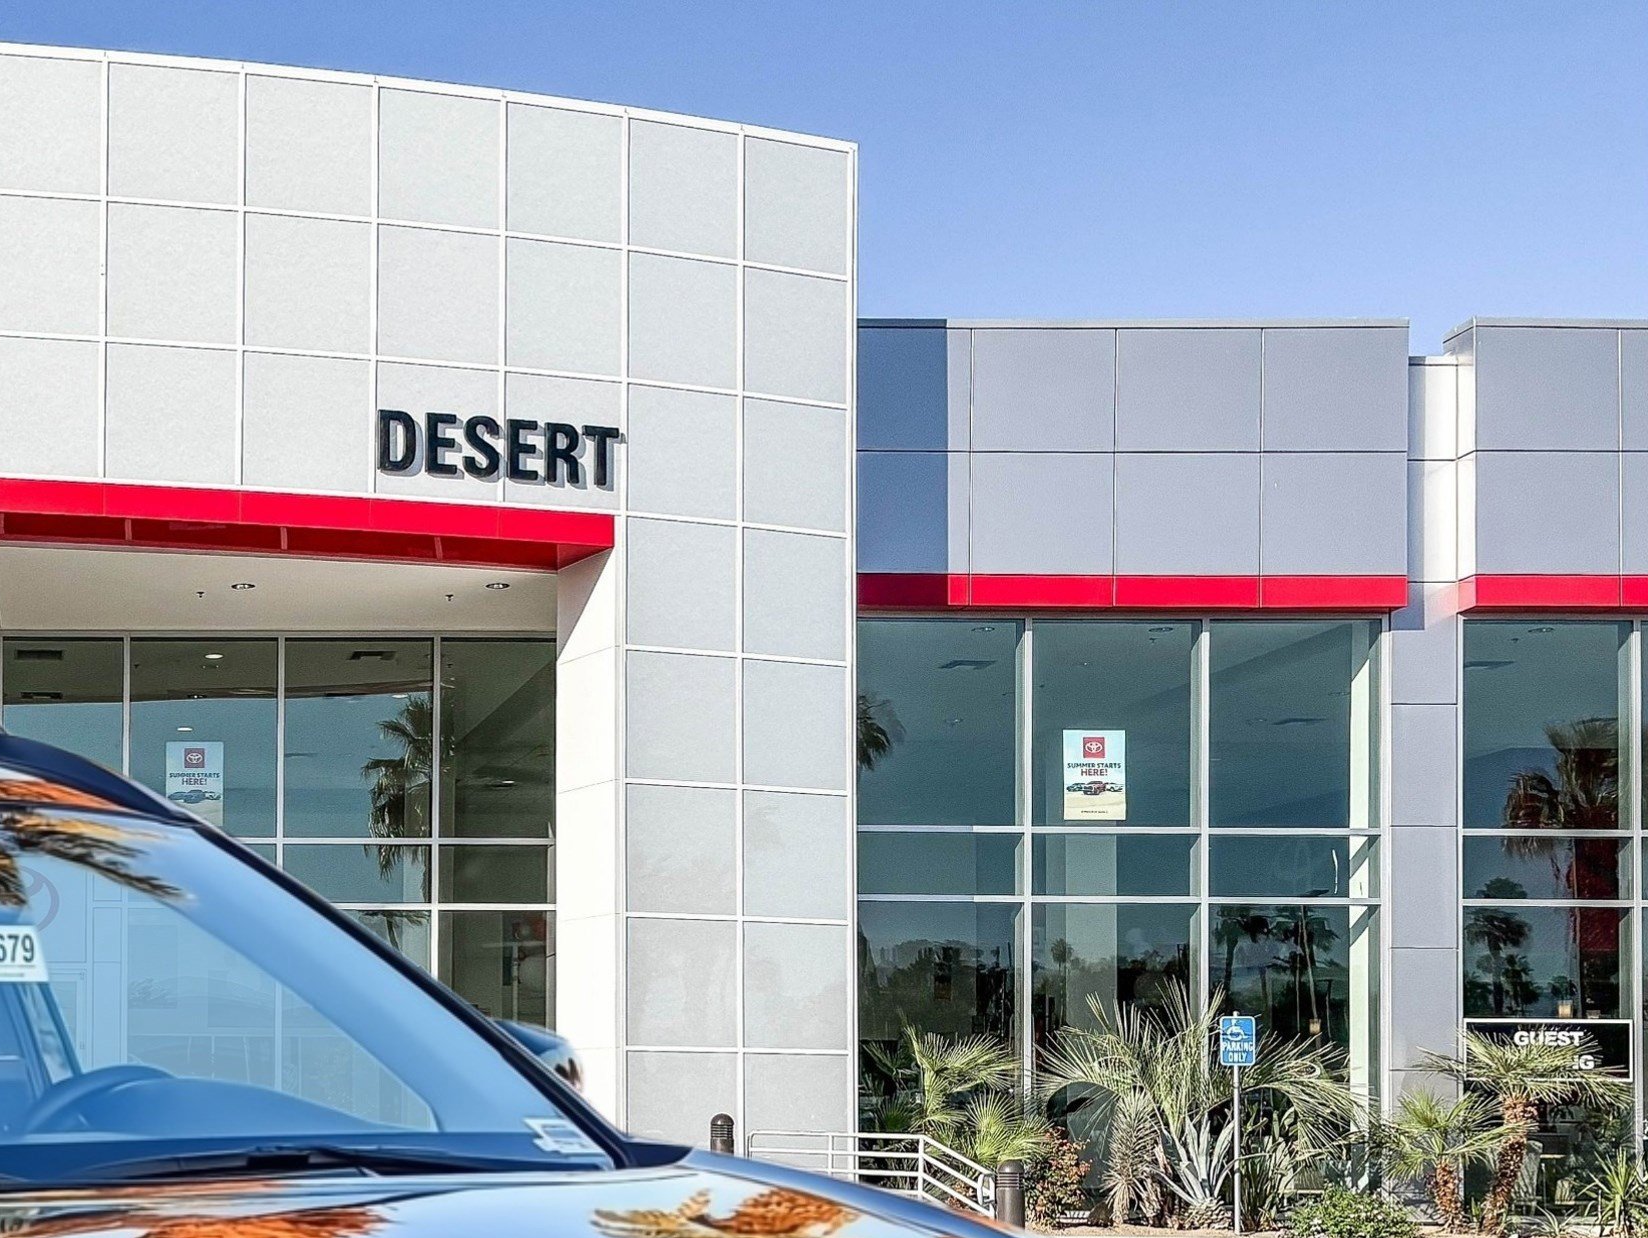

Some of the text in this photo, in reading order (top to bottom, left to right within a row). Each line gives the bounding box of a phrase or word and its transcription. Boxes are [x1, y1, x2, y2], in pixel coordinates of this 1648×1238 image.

[377, 409, 620, 487] DESERT
[1080, 768, 1108, 777] HERE!
[181, 778, 207, 786] HERE!
[1513, 1030, 1584, 1047] GUEST
[1222, 1041, 1254, 1052] PARKING
[1228, 1052, 1248, 1062] ONLY
